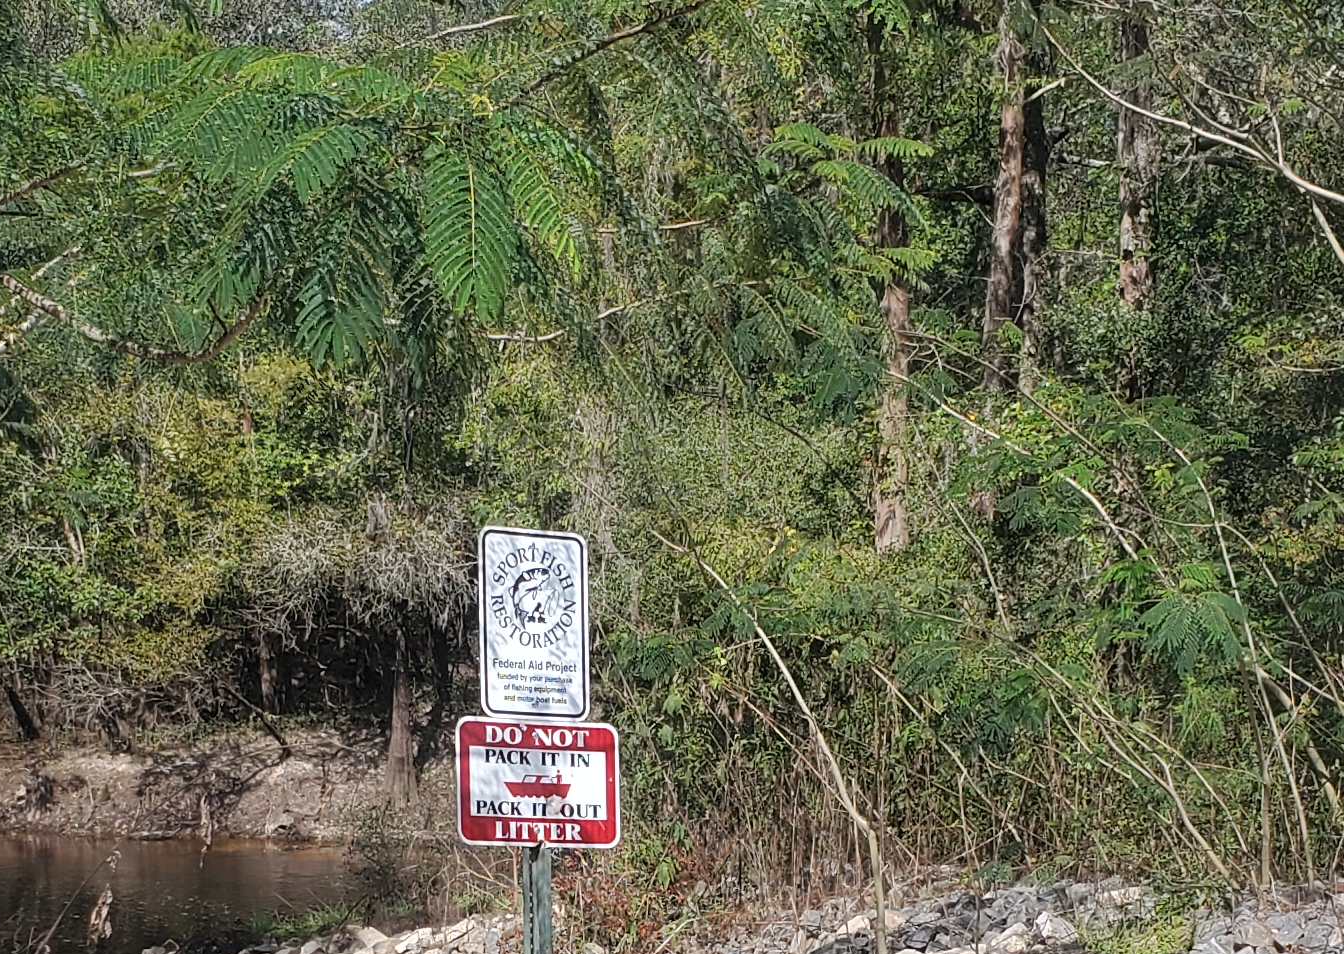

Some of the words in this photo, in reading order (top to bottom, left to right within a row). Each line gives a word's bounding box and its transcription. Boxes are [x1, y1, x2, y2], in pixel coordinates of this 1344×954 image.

[493, 548, 539, 586] SPORT
[540, 551, 575, 590] FISH
[490, 594, 576, 648] RESTORATION
[493, 658, 526, 670] Federal
[528, 660, 543, 670] Aid
[546, 662, 577, 674] Project
[498, 672, 518, 680] funded
[520, 674, 528, 682] by
[512, 684, 532, 693] fishing
[485, 725, 522, 745] DO
[534, 728, 589, 748] NOT
[485, 748, 532, 766] PACK
[541, 751, 560, 766] IT
[570, 753, 590, 767] IN
[476, 800, 522, 816] PACK
[532, 802, 547, 817] IT
[560, 804, 602, 818] OUT
[495, 821, 582, 840] LITTER
